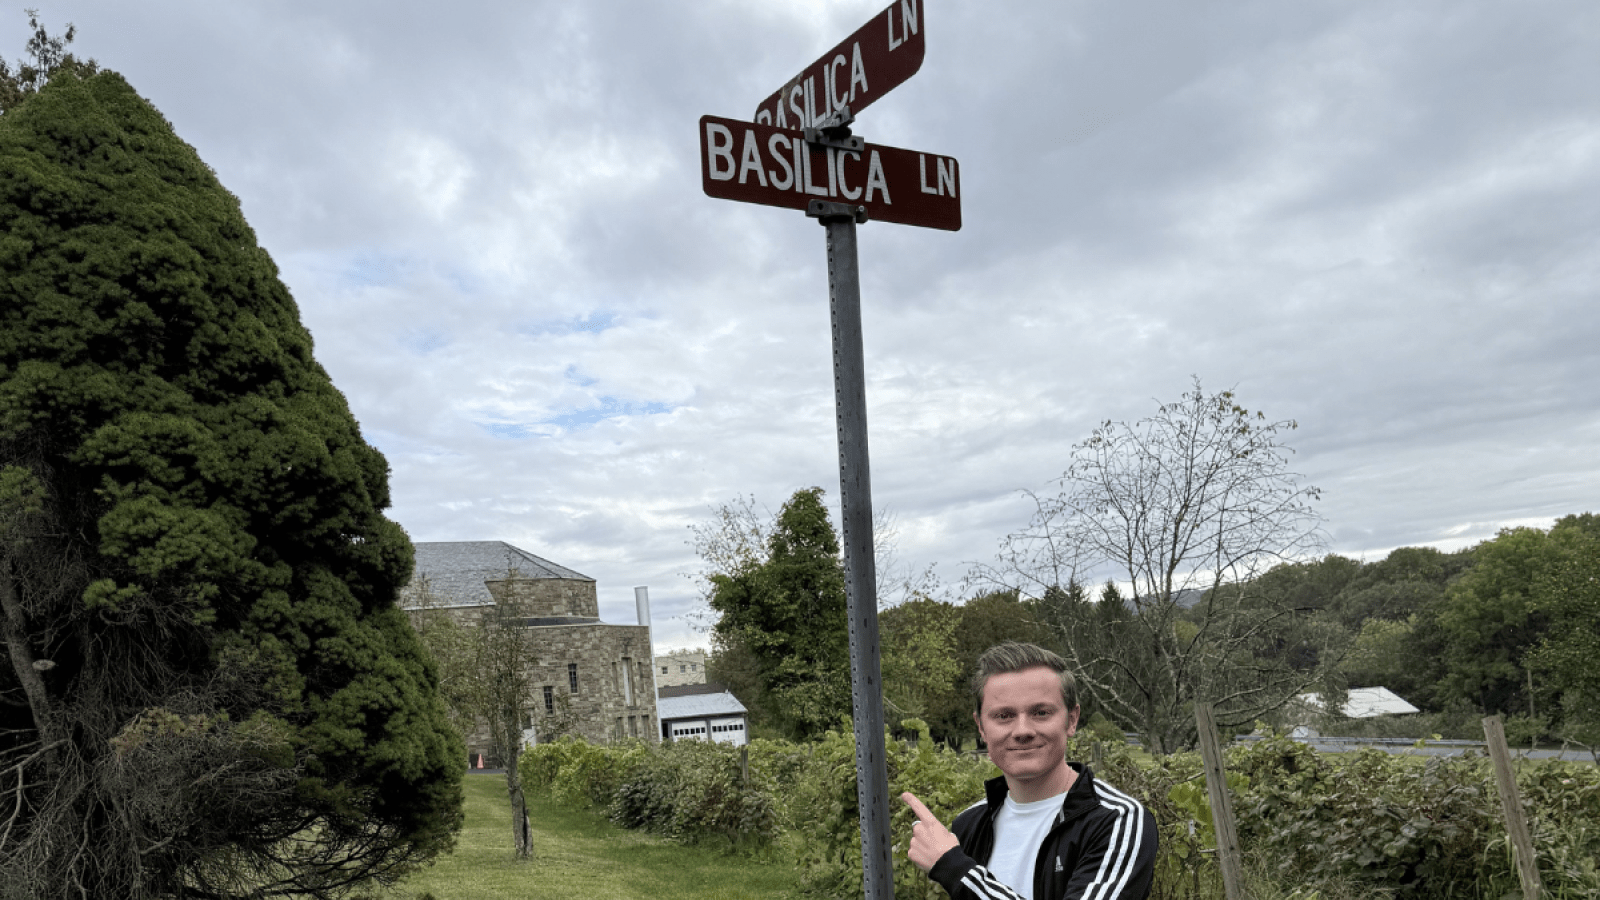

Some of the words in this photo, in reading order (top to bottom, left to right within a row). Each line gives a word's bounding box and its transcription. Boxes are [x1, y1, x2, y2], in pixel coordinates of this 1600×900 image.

[888, 0, 918, 51] LN
[706, 122, 892, 205] BASILICA
[919, 154, 957, 198] LN
